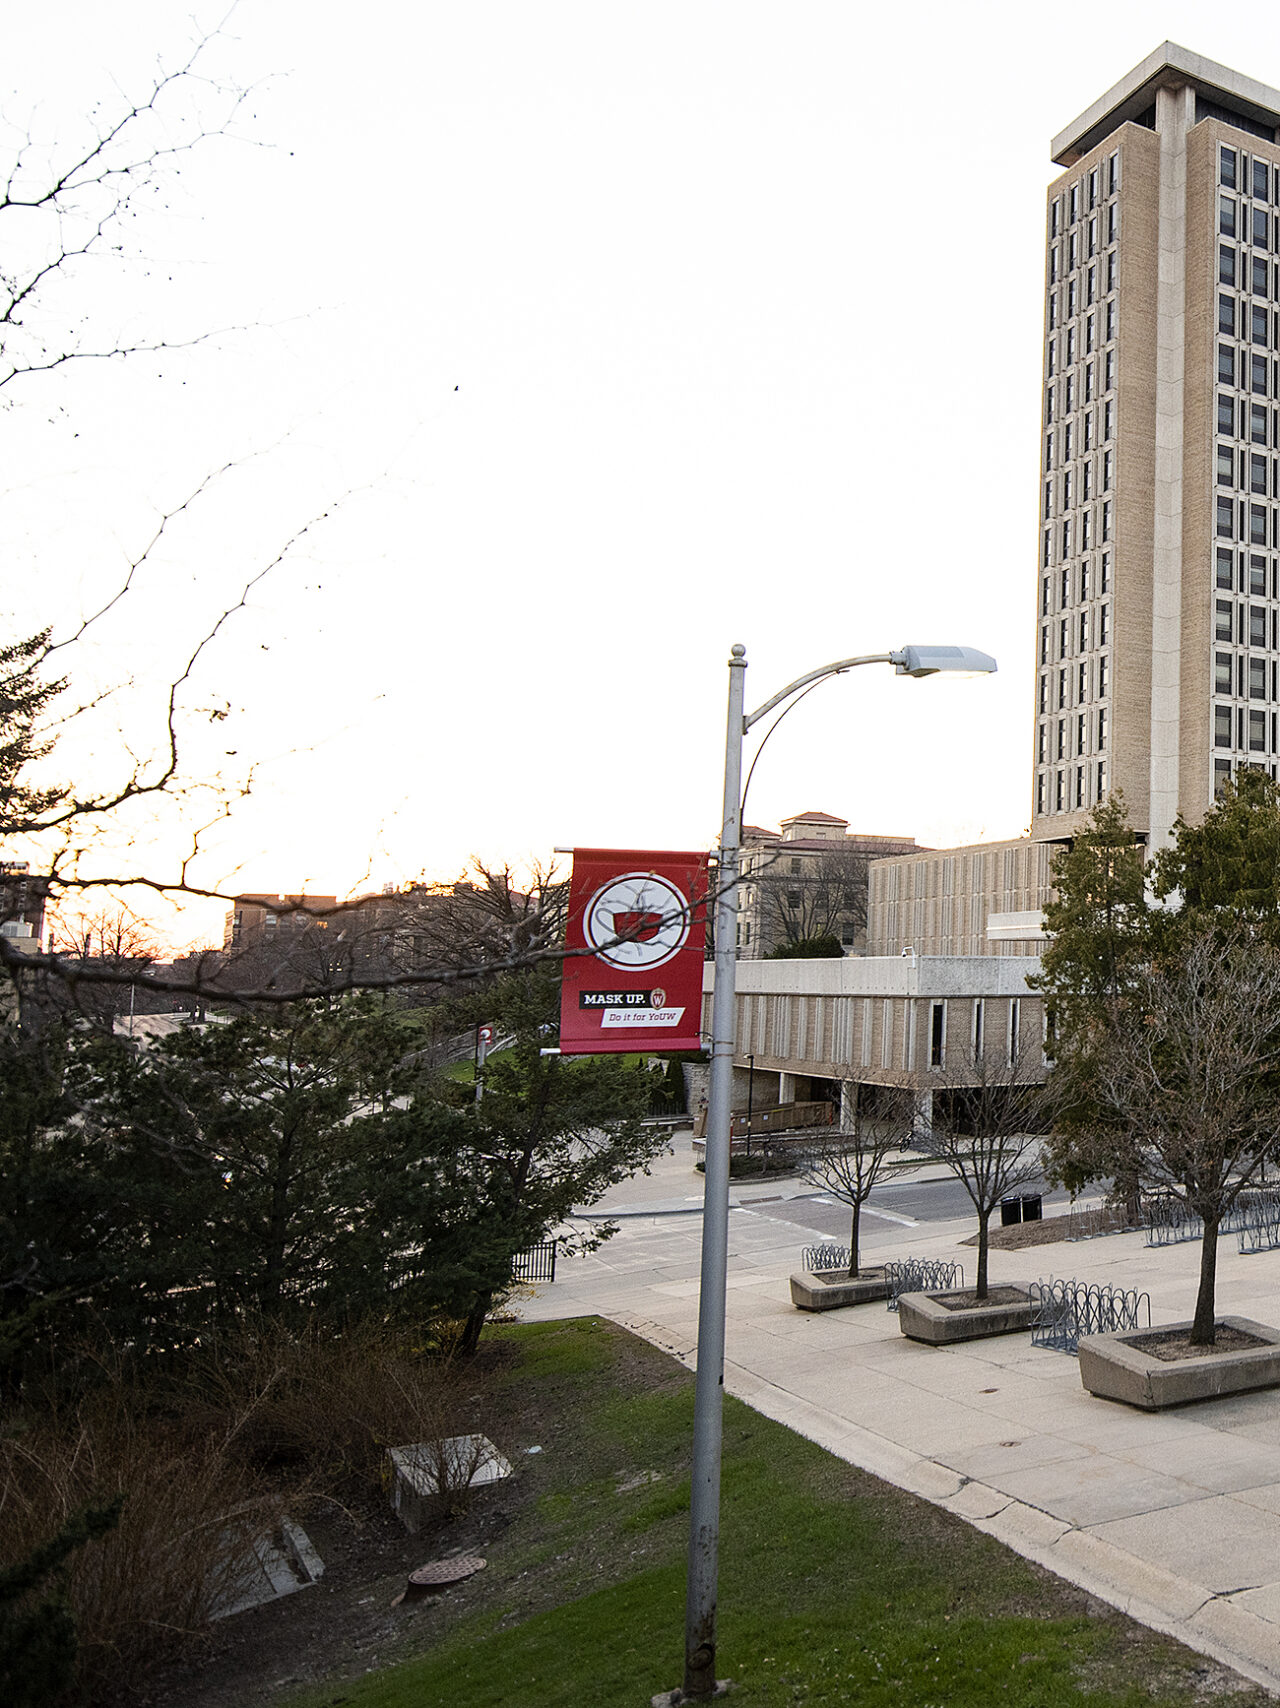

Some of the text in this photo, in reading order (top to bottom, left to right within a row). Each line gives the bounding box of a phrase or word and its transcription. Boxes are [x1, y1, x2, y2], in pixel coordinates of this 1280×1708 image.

[584, 994, 646, 1004] MASK UP.
[653, 995, 663, 1006] W
[609, 1014, 621, 1022] Do
[623, 1013, 631, 1021] it
[633, 1013, 646, 1021] for
